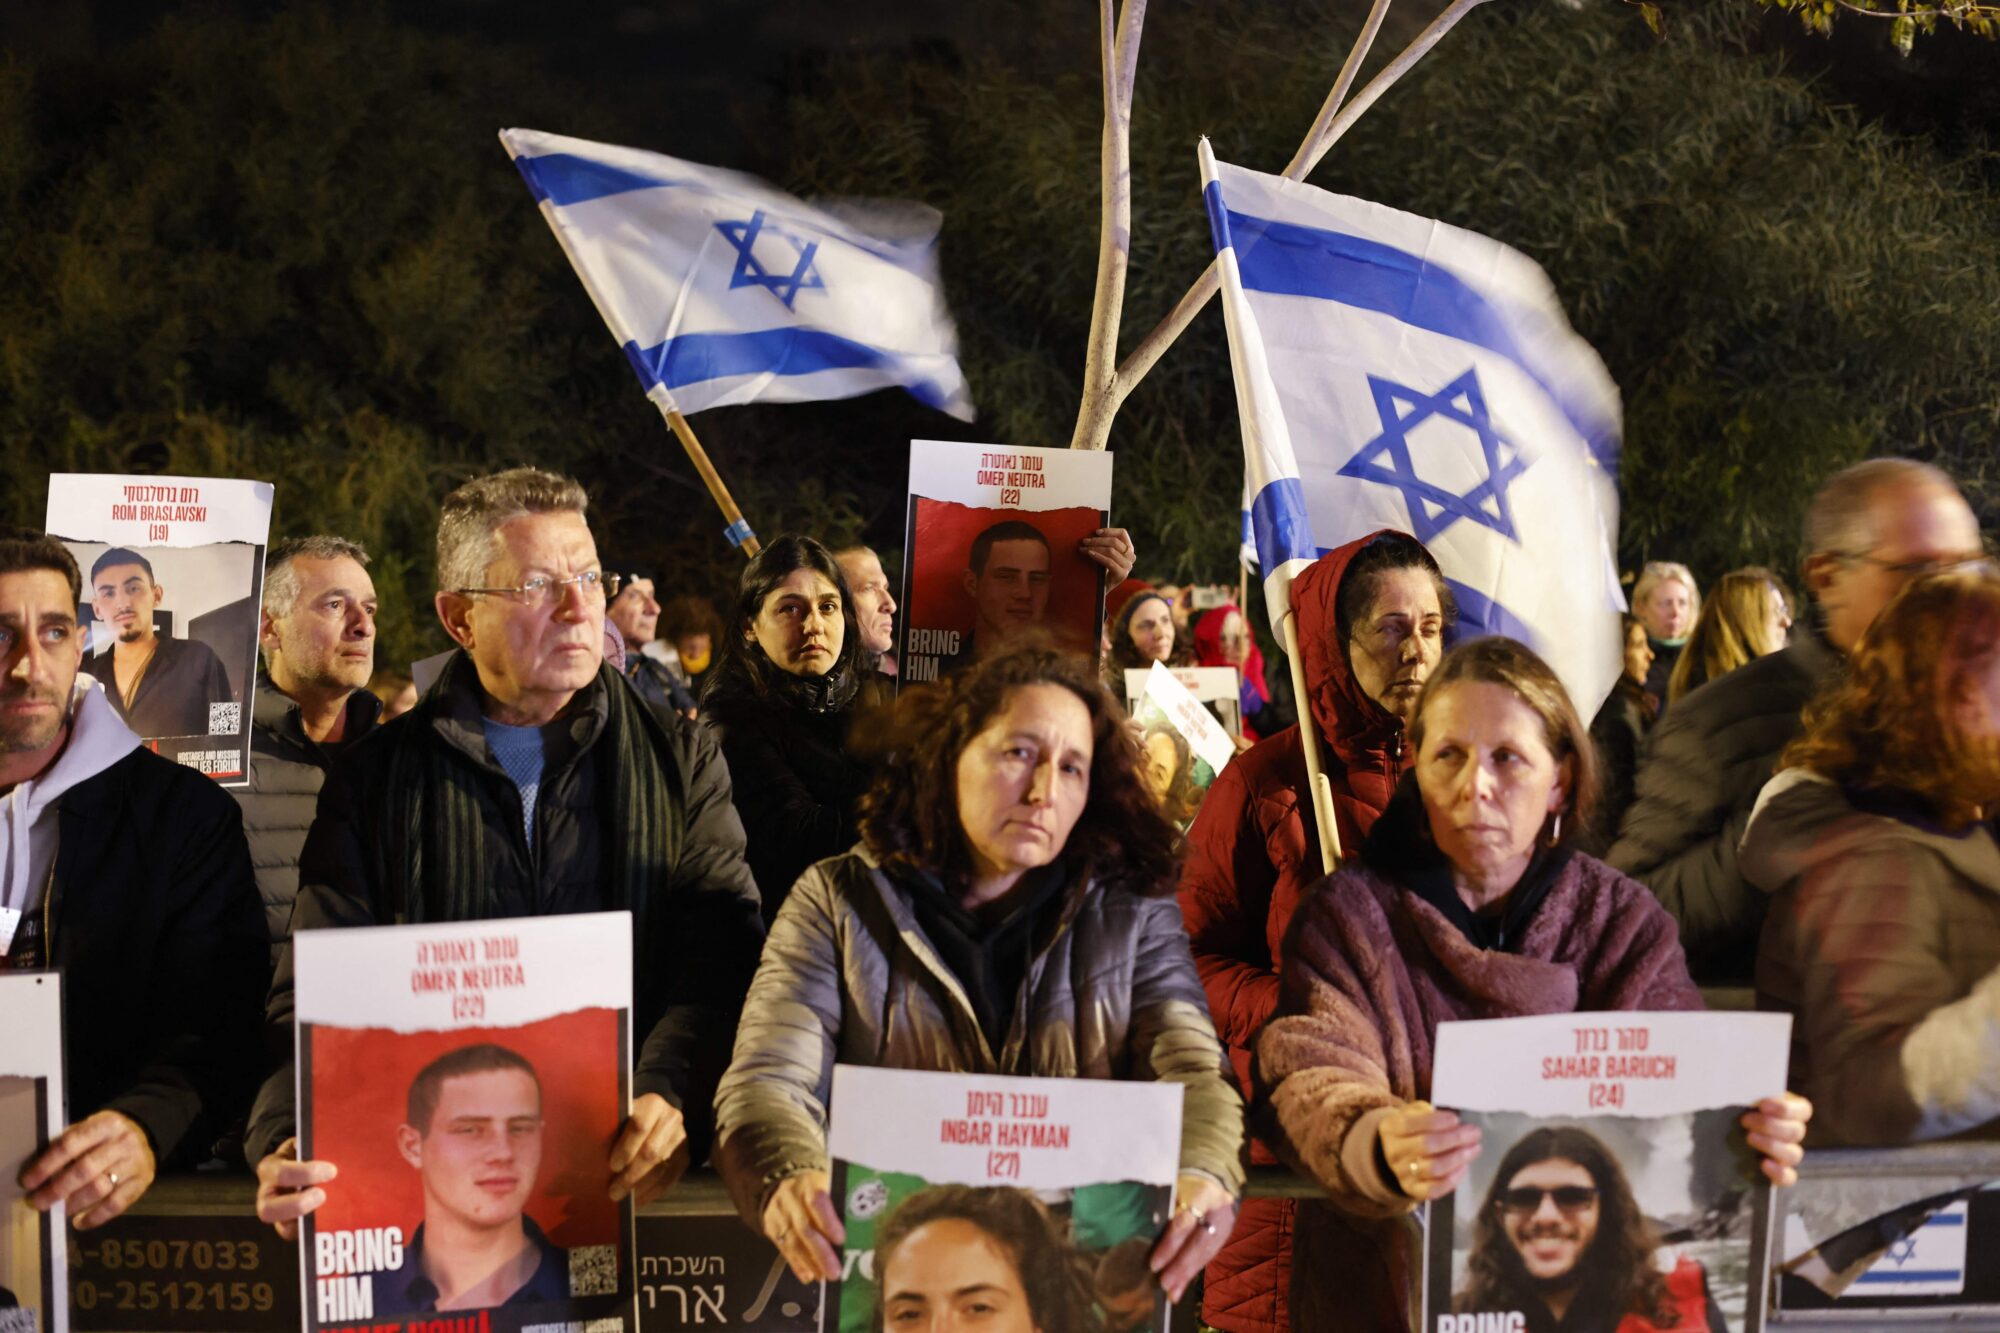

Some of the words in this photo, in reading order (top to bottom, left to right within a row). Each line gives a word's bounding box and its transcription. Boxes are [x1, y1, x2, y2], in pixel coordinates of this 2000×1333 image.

[981, 453, 1017, 470] נאוטרה
[1019, 455, 1043, 471] עומר
[977, 470, 1004, 486] OMER
[1007, 472, 1046, 489] NEUTRA
[123, 485, 177, 503] ברסלבסקי
[180, 487, 199, 504] רום
[1001, 488, 1021, 506] (22)
[112, 504, 137, 521] ROM
[140, 505, 207, 522] BRASLAVSKI
[149, 524, 169, 542] (19)
[908, 628, 960, 656] BRING
[906, 655, 939, 682] HIM
[177, 751, 205, 762] HOSTAGES
[205, 750, 217, 761] AND
[216, 749, 241, 760] MISSING
[213, 759, 241, 773] FORUM
[411, 968, 457, 993] OMER
[462, 964, 525, 989] NEUTRA
[453, 993, 485, 1020] (22)
[1542, 1056, 1600, 1079] SAHAR
[1606, 1056, 1676, 1078] BARUCH
[967, 1090, 1003, 1119] הימן
[1009, 1092, 1048, 1118] ענבר
[1589, 1081, 1625, 1109] (24)
[941, 1119, 992, 1145] INBAR
[998, 1122, 1070, 1149] HAYMAN
[987, 1149, 1021, 1179] (27)
[315, 1226, 404, 1276] BRING
[641, 1256, 725, 1276] השכרת
[70, 1280, 274, 1311] 0-2512159
[317, 1275, 374, 1323] HIM
[642, 1284, 728, 1324] ארי
